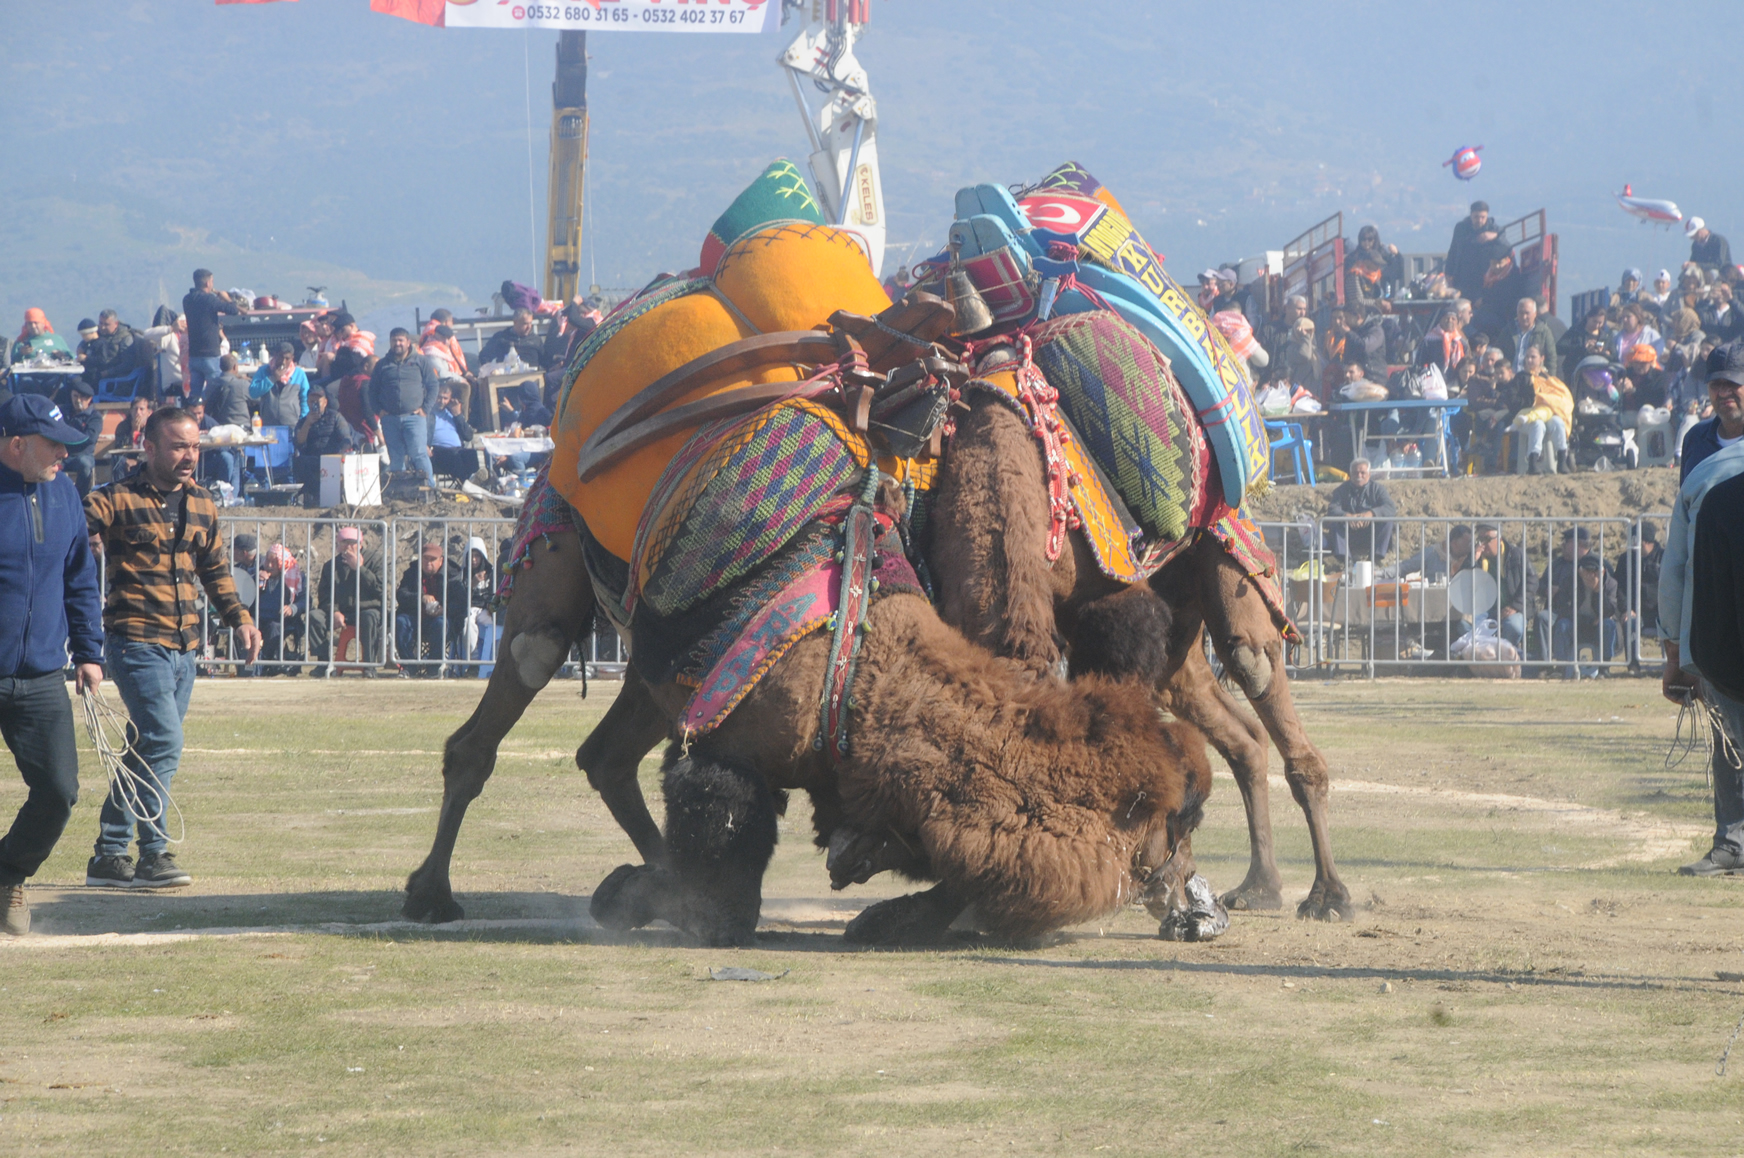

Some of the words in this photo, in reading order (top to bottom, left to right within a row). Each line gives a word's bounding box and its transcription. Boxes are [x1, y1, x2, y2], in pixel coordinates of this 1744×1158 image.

[527, 6, 560, 19] 0532
[565, 7, 590, 20] 680
[595, 8, 608, 22] 31
[612, 9, 629, 22] 65
[643, 9, 676, 23] 0532
[680, 10, 706, 24] 402
[710, 10, 725, 24] 37
[729, 10, 745, 24] 67
[861, 178, 873, 220] KELES
